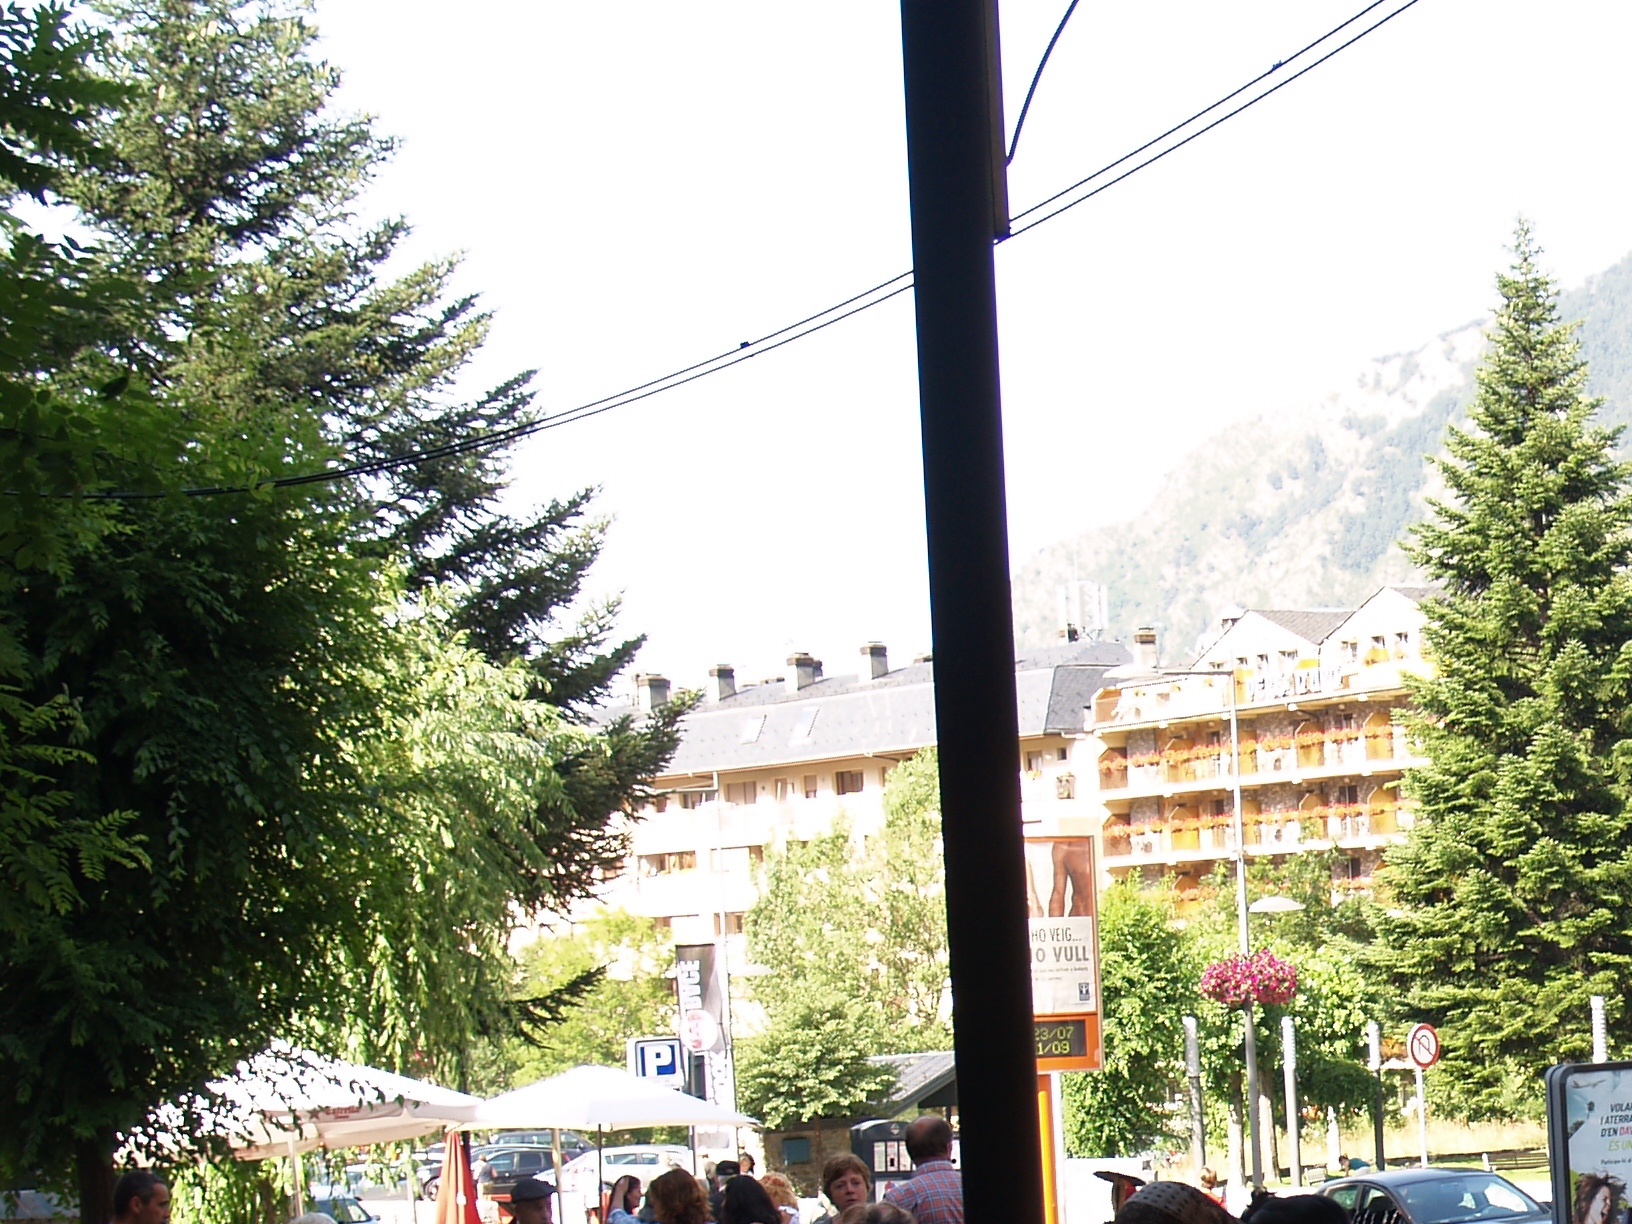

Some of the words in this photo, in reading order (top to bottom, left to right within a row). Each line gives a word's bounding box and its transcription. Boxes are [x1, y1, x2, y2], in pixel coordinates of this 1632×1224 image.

[1053, 945, 1089, 962] VULL
[644, 1045, 672, 1077] P
[1622, 1139, 1632, 1150] UN
